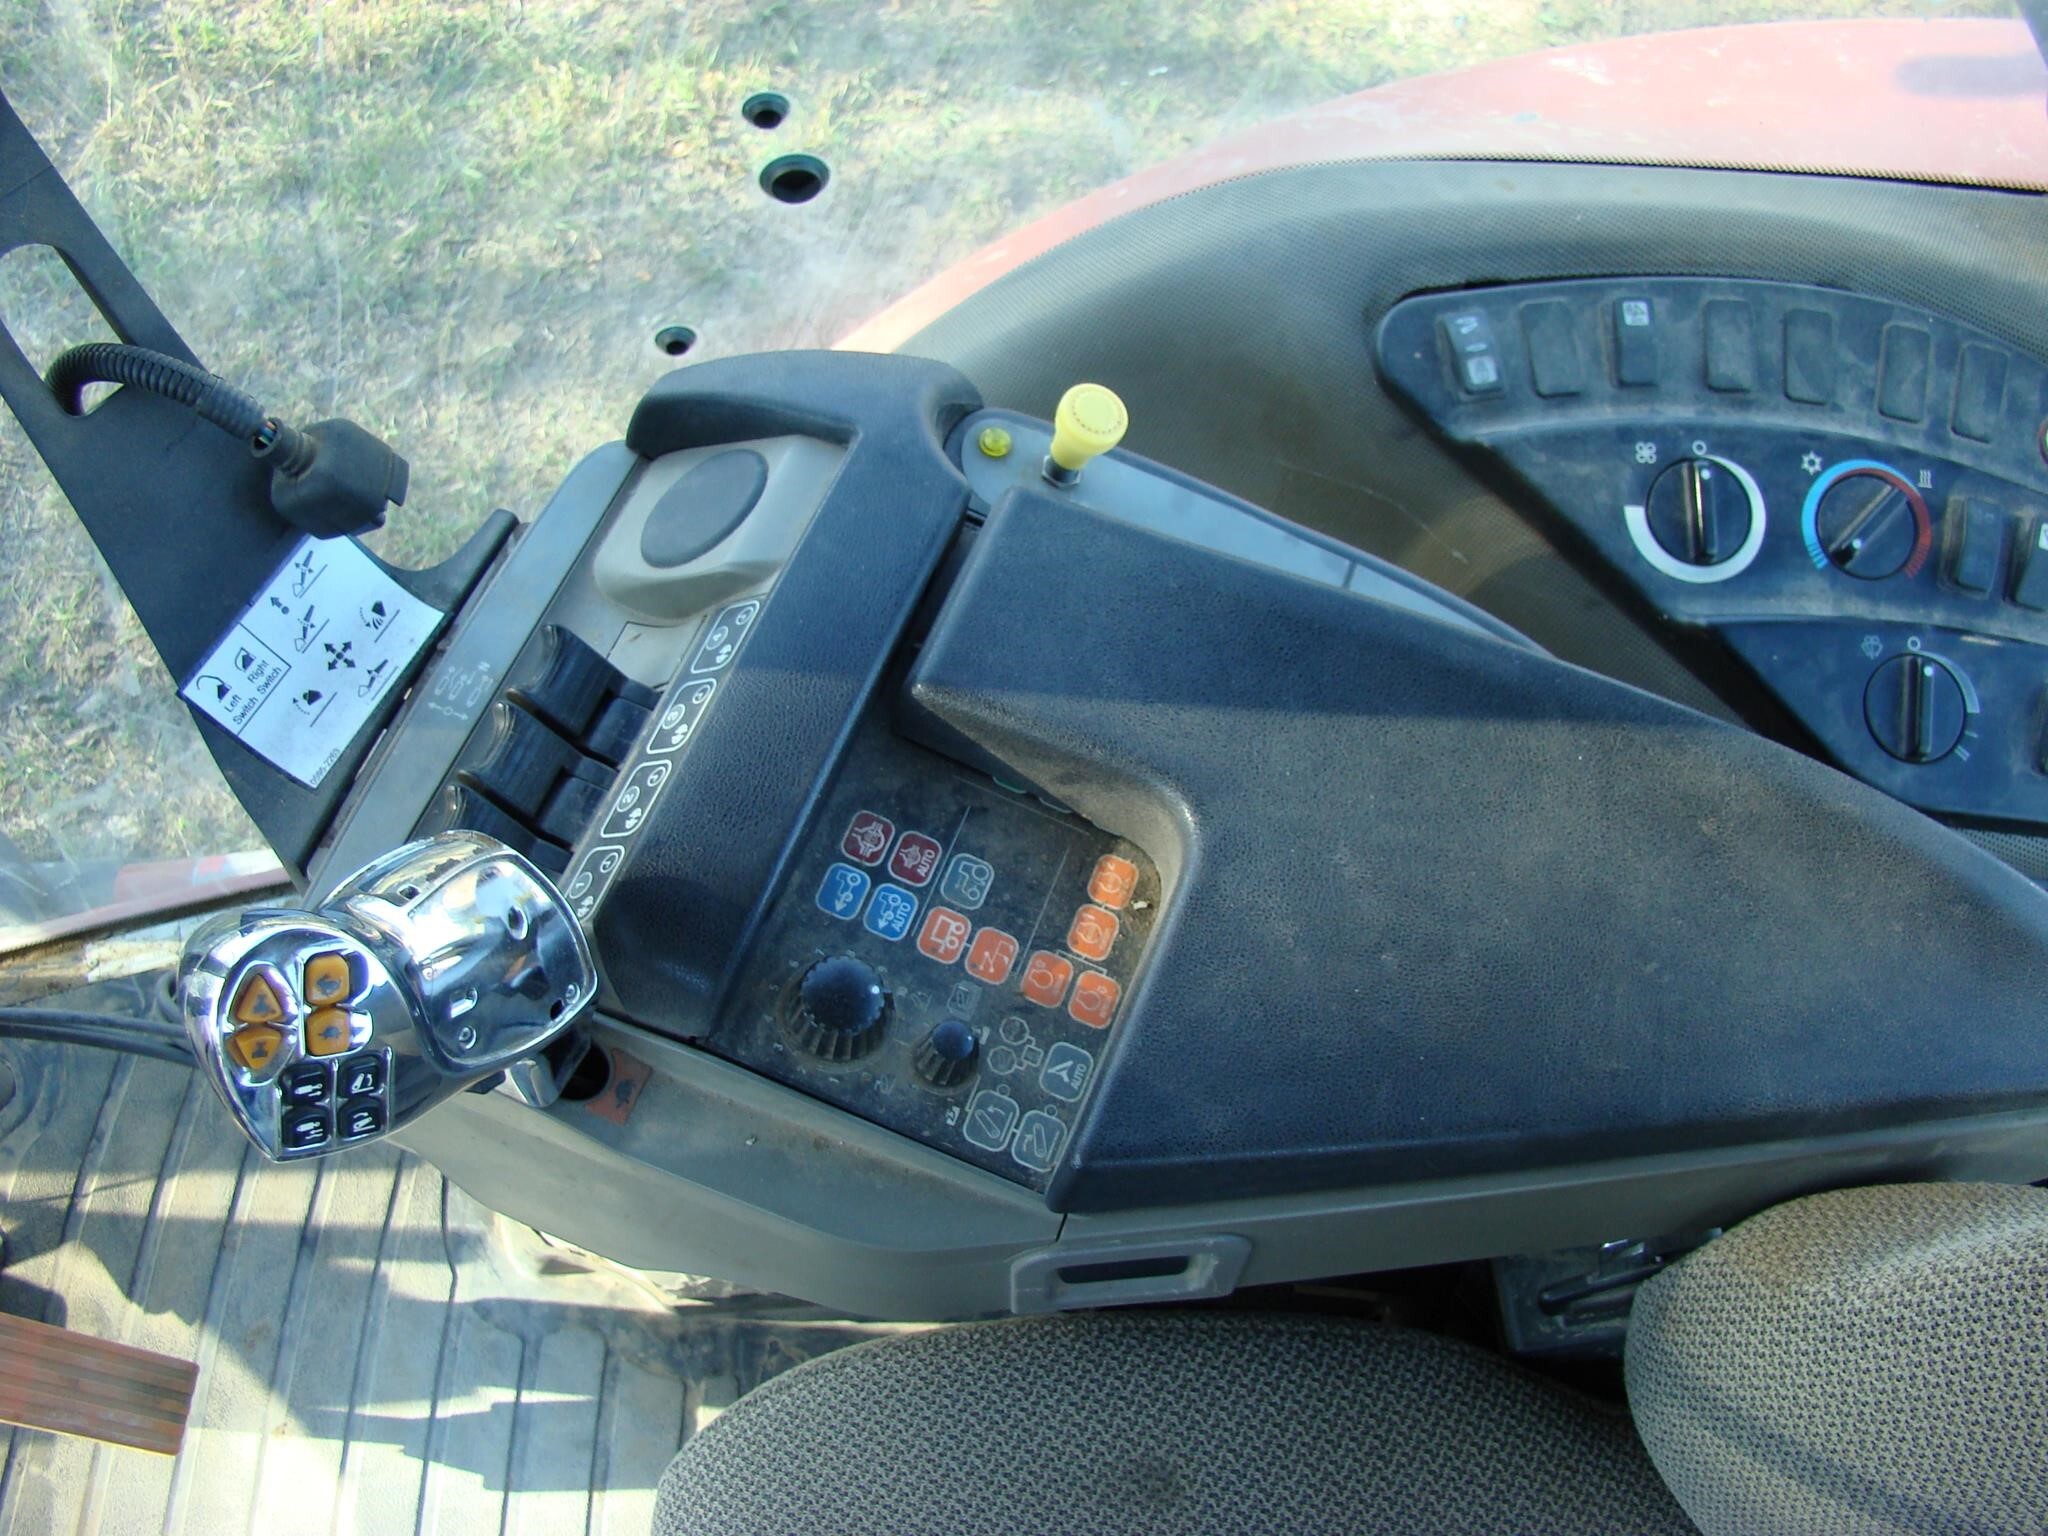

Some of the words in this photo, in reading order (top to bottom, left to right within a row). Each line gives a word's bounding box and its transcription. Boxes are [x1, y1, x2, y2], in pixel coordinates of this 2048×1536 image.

[247, 660, 269, 683] Right
[257, 667, 282, 694] Switch
[224, 694, 242, 712] Left
[233, 697, 259, 725] Switch
[916, 849, 936, 877] AUTO
[891, 902, 911, 932] AUTO
[1071, 1063, 1088, 1090] AUTO
